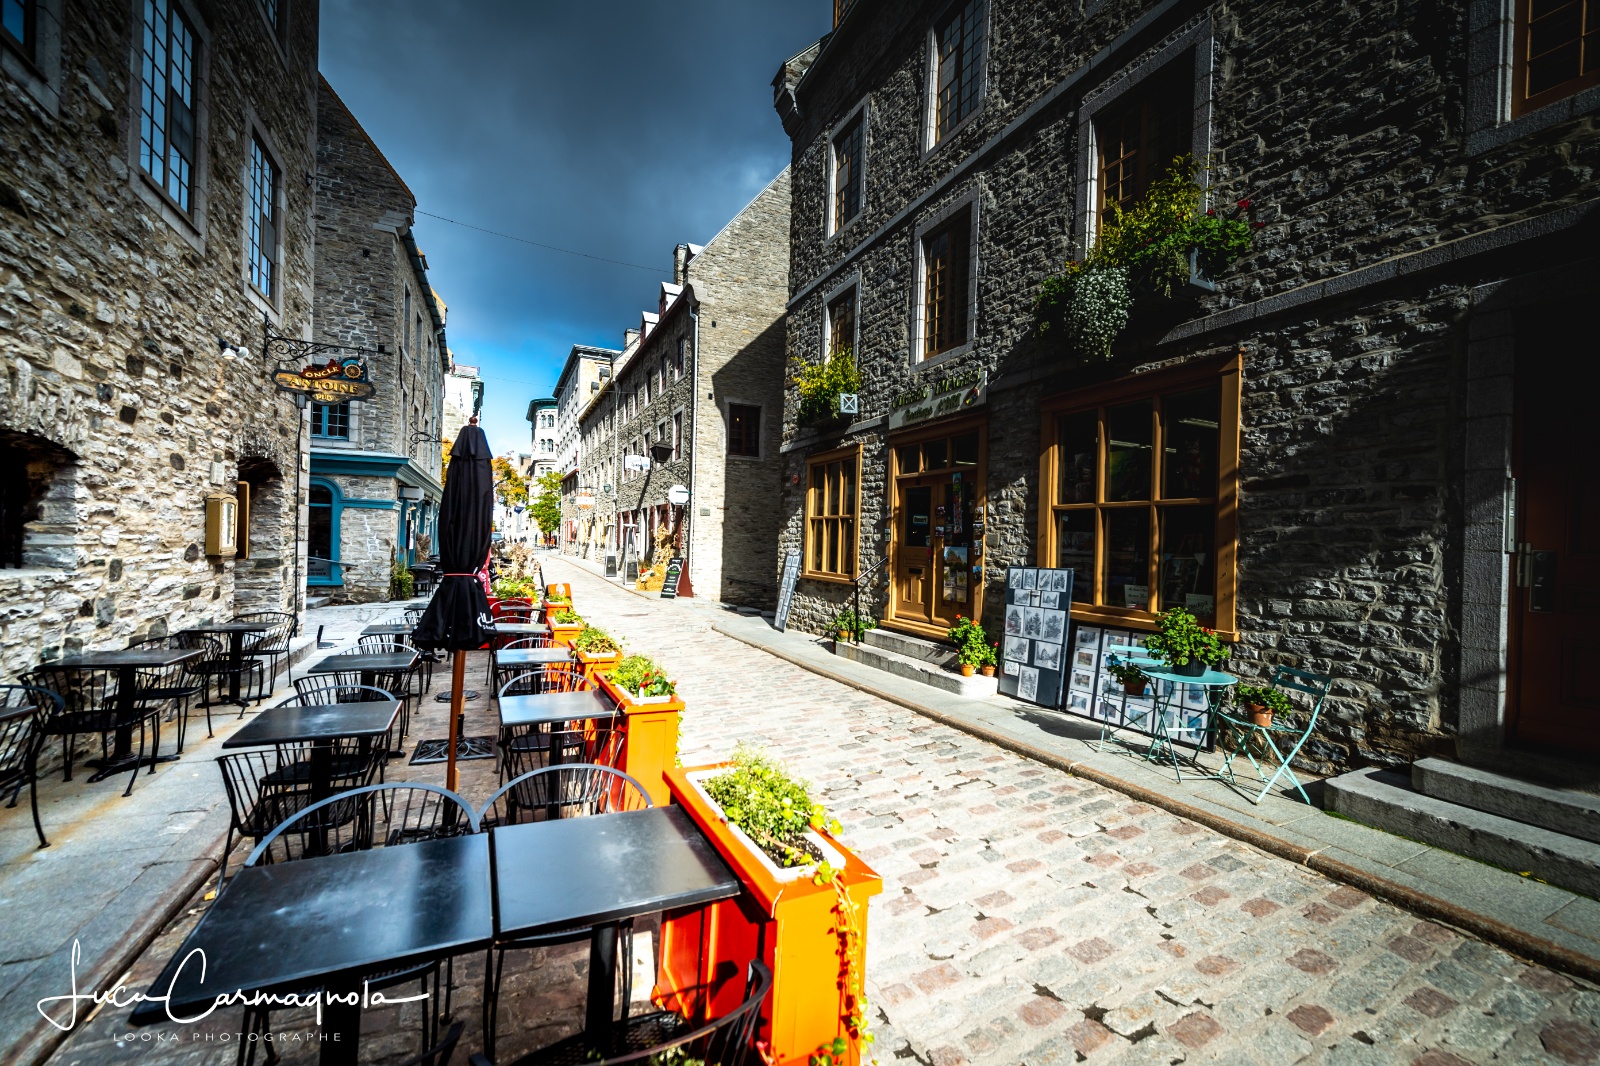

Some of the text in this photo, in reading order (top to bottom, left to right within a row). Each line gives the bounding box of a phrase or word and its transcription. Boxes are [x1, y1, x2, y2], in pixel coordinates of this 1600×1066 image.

[305, 366, 339, 378] ONCLE
[289, 376, 358, 394] ANTOINE
[315, 393, 333, 401] PUB
